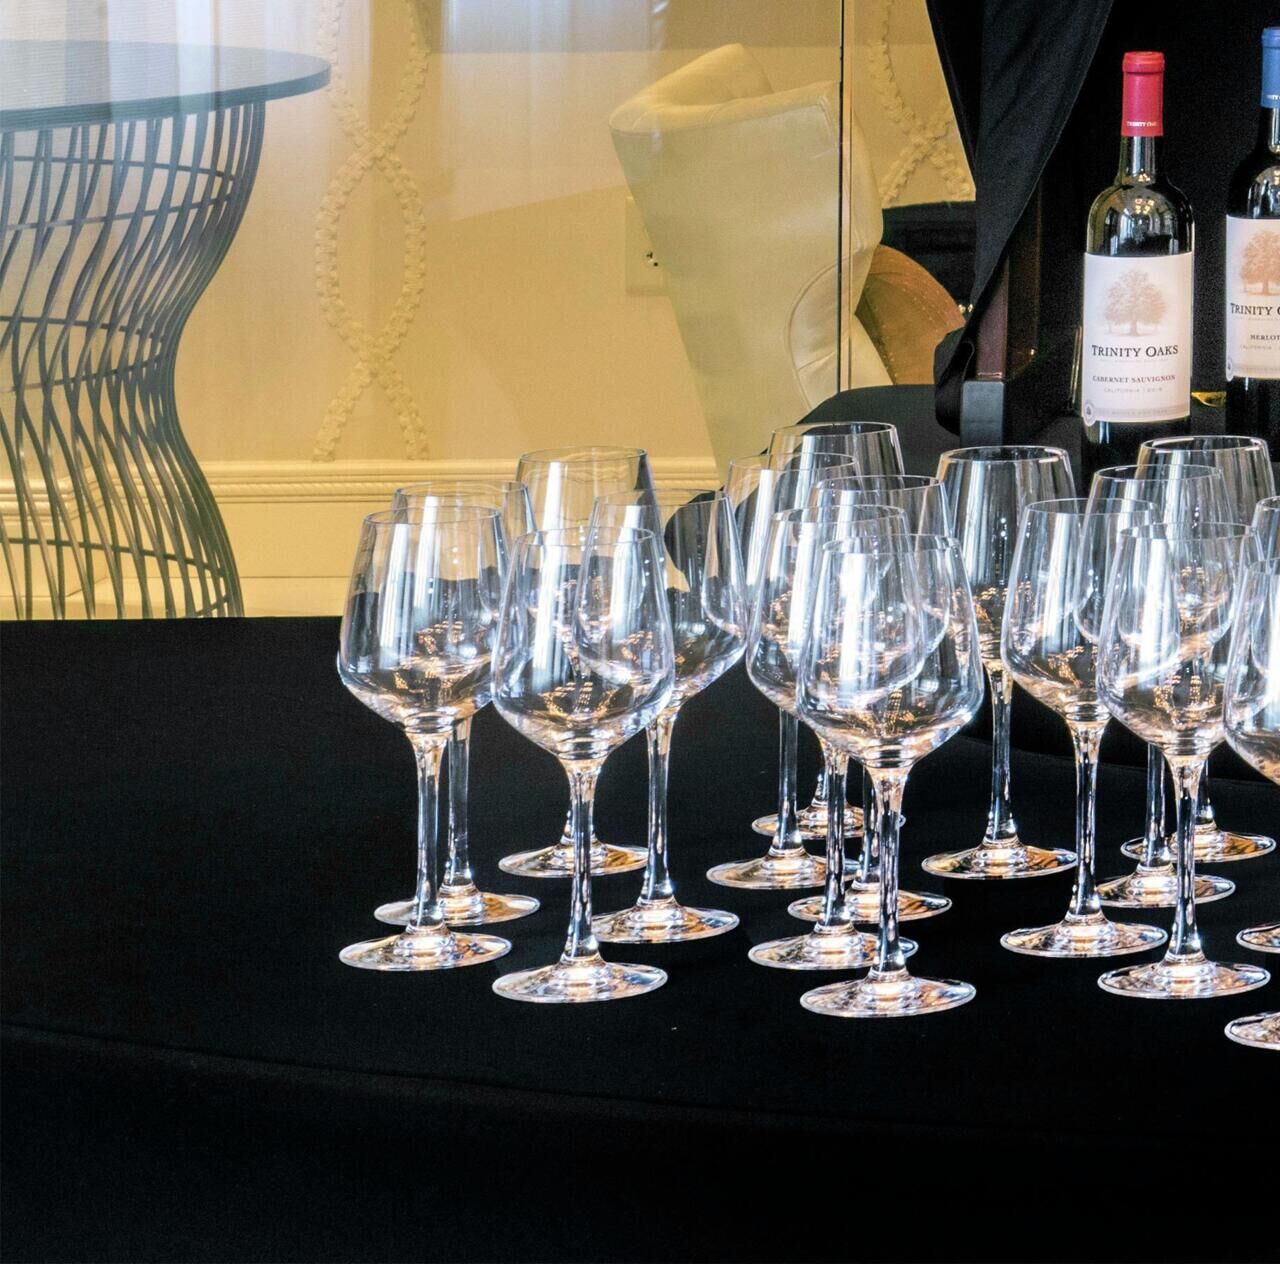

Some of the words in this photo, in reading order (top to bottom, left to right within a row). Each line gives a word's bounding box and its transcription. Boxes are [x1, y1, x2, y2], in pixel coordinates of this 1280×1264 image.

[1229, 302, 1273, 316] TRINITY
[1091, 344, 1142, 358] TRINITY
[1145, 344, 1179, 358] OAKS
[1092, 375, 1129, 383] CABERNET
[1131, 374, 1176, 383] SAUVIGNON
